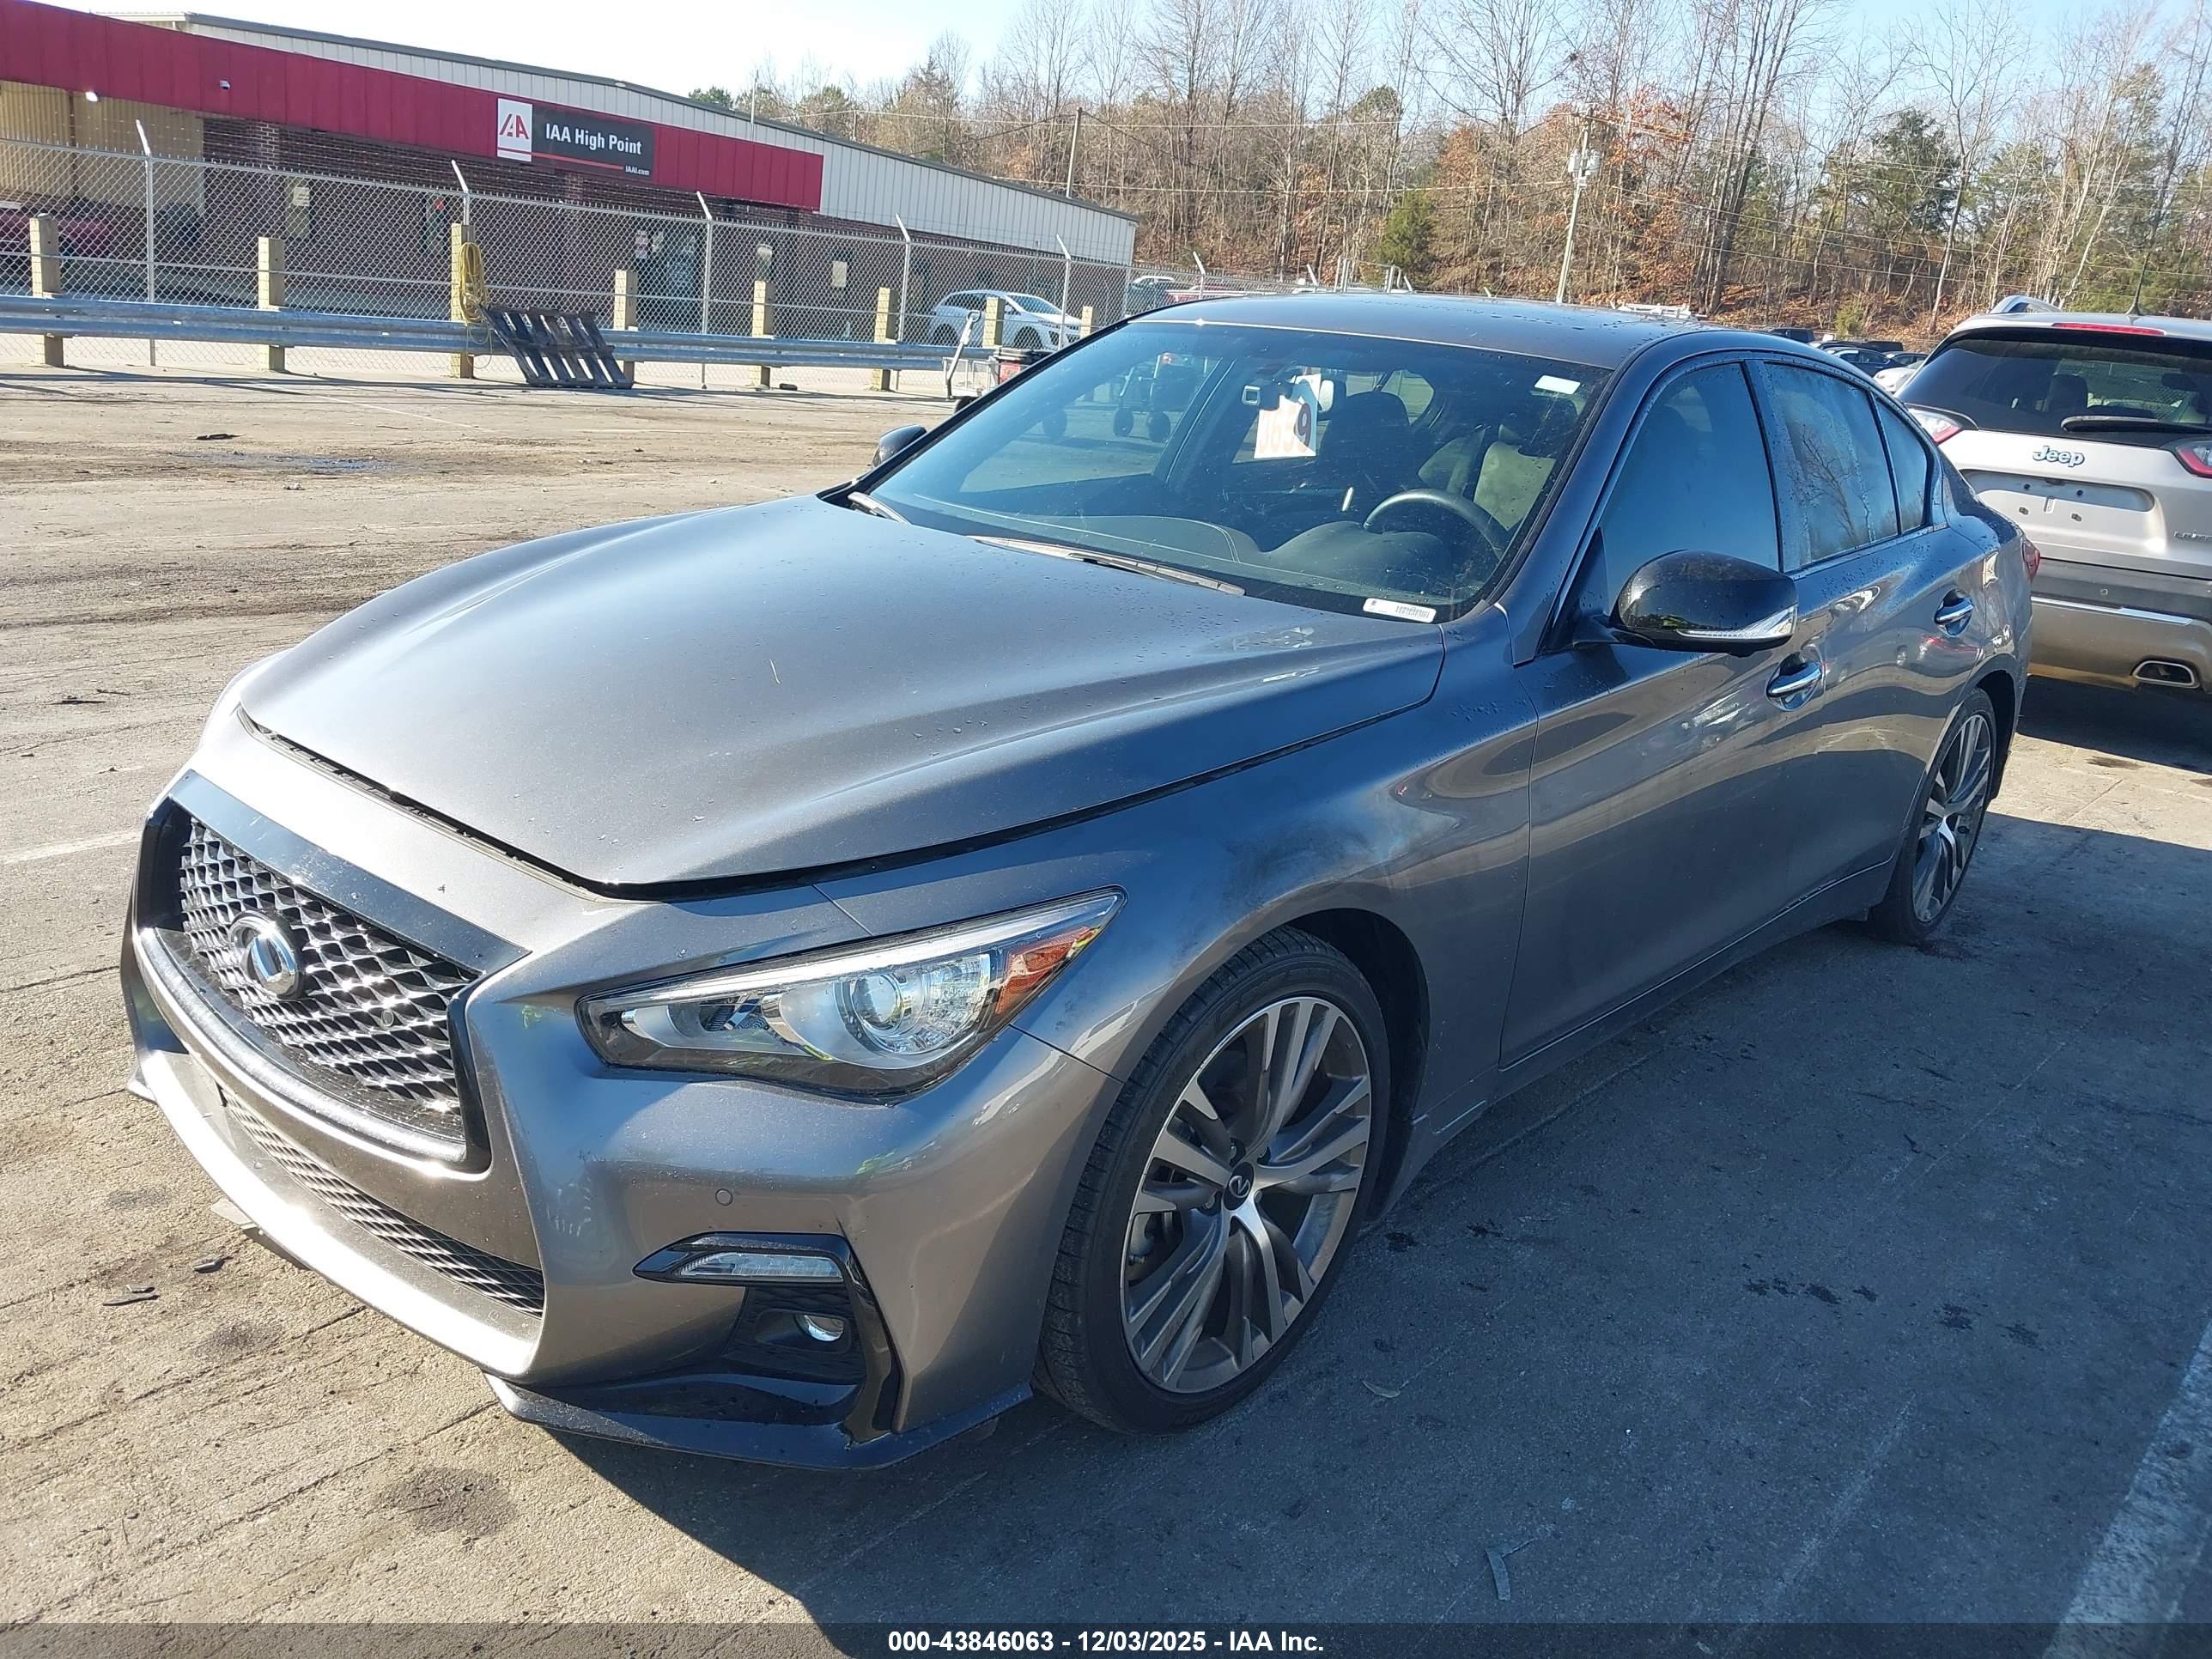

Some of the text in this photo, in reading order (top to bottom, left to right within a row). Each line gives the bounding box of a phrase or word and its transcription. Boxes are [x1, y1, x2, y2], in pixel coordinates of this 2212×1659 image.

[545, 123, 642, 155] IAA High Point
[2033, 445, 2085, 467] Jeep
